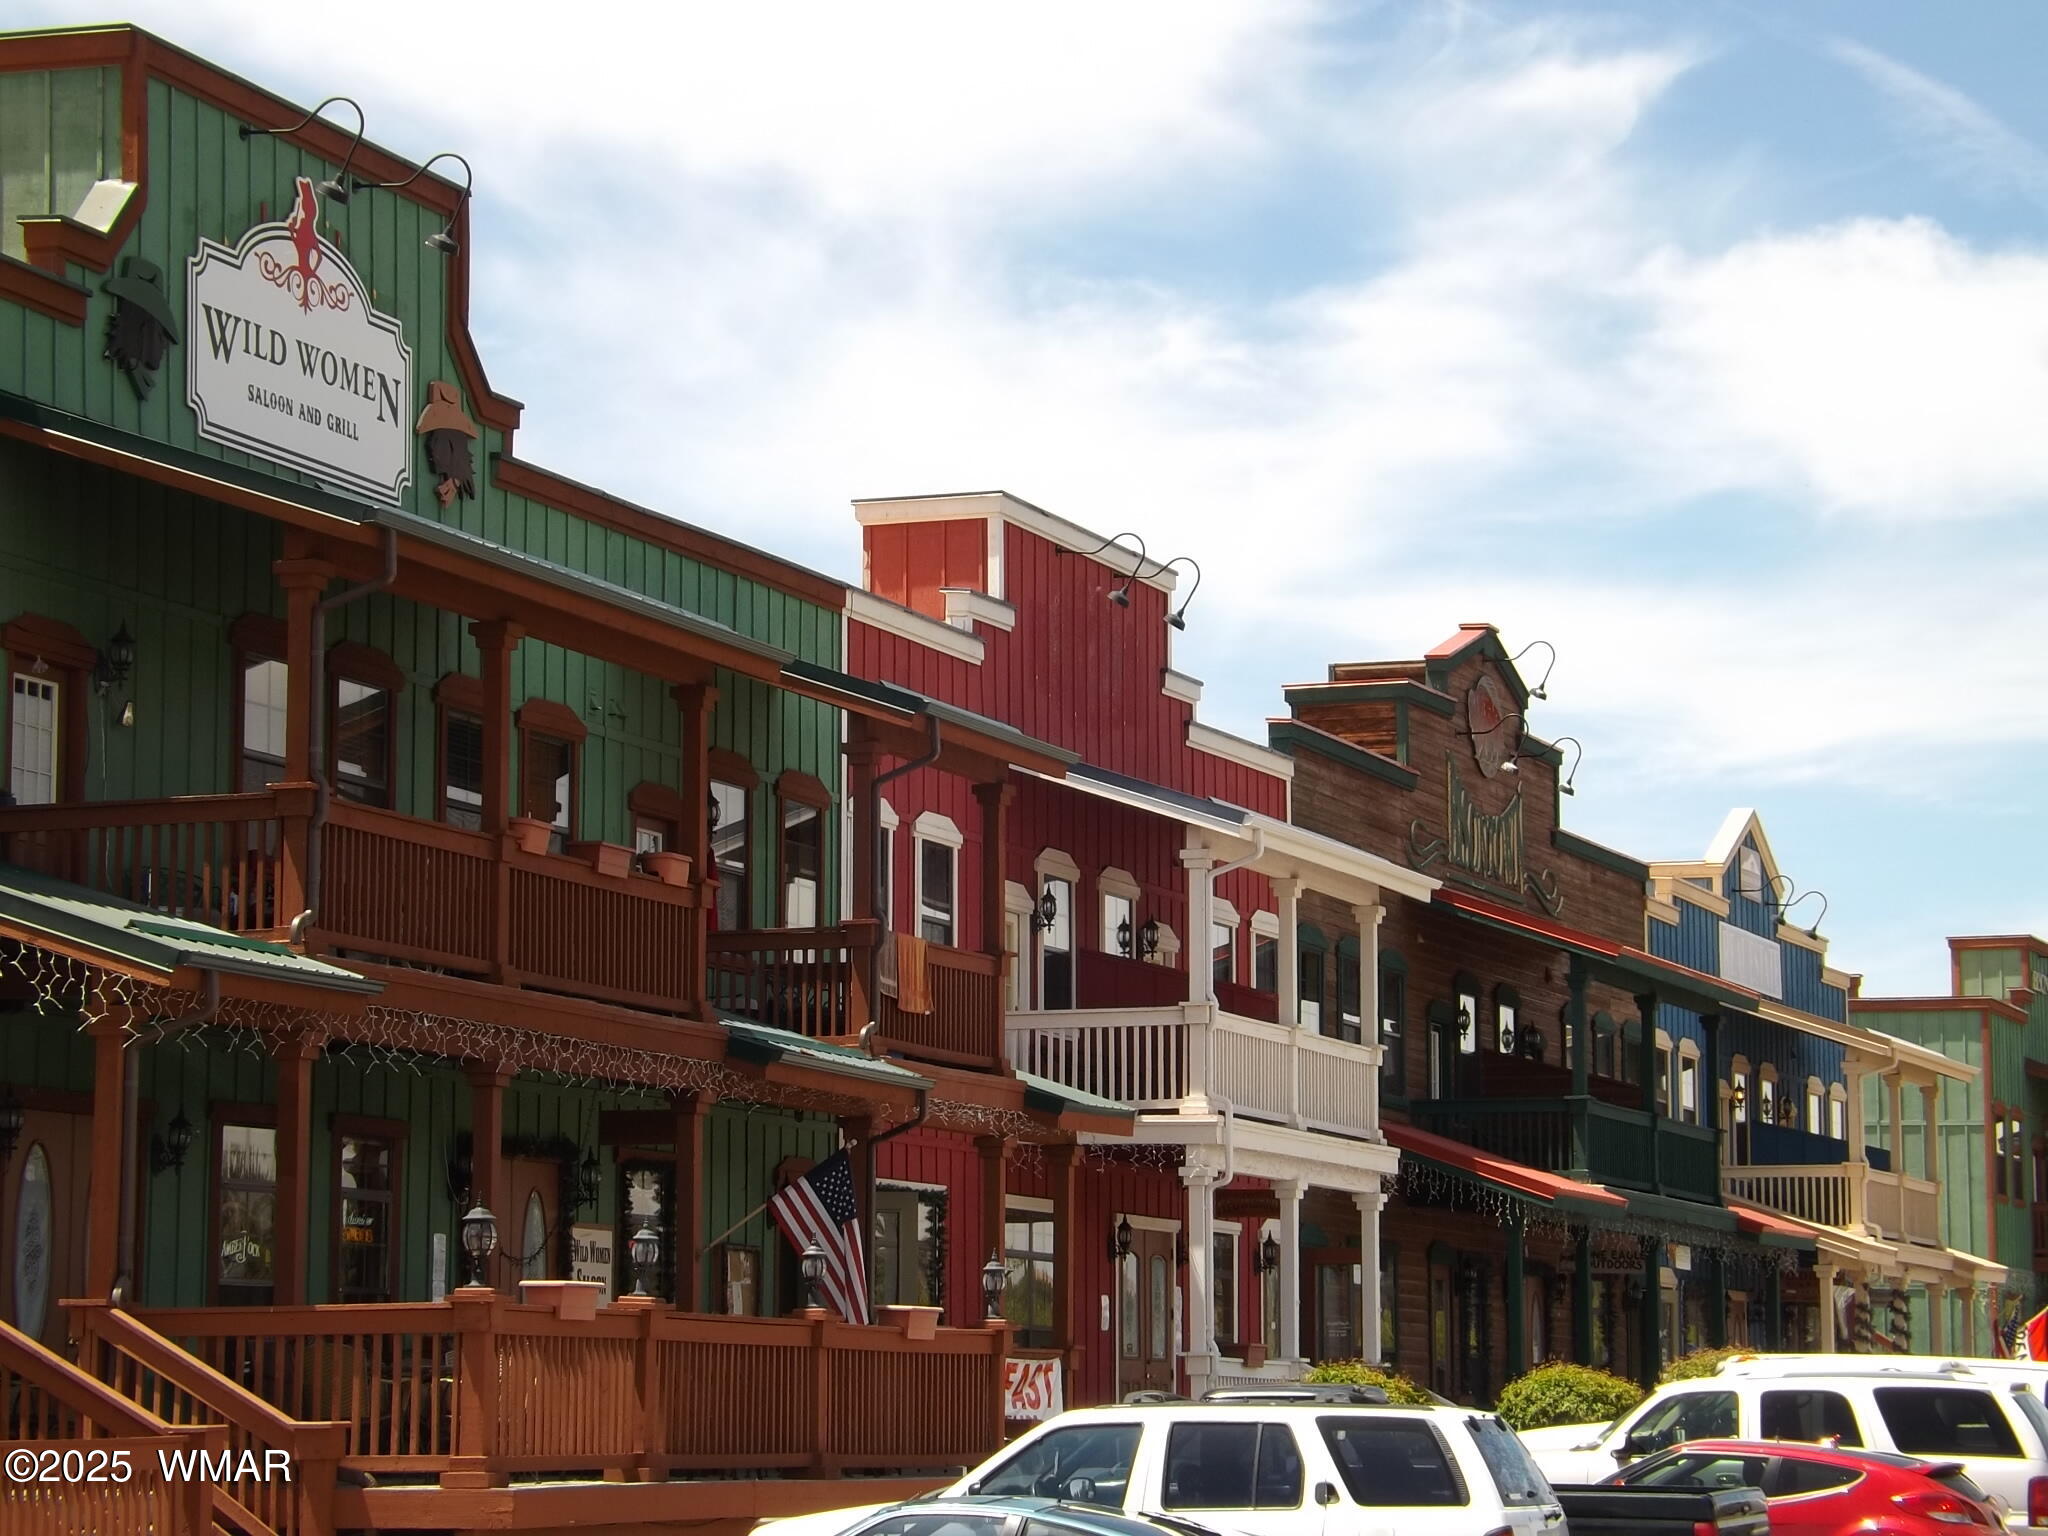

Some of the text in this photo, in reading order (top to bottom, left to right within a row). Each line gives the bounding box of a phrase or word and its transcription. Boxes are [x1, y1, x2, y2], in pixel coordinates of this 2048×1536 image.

[202, 303, 401, 428] WILD WOMEN
[247, 383, 359, 441] SALOON AND GRILL
[573, 1238, 611, 1264] WILD WOMEN
[1590, 1256, 1642, 1270] UTDOORS
